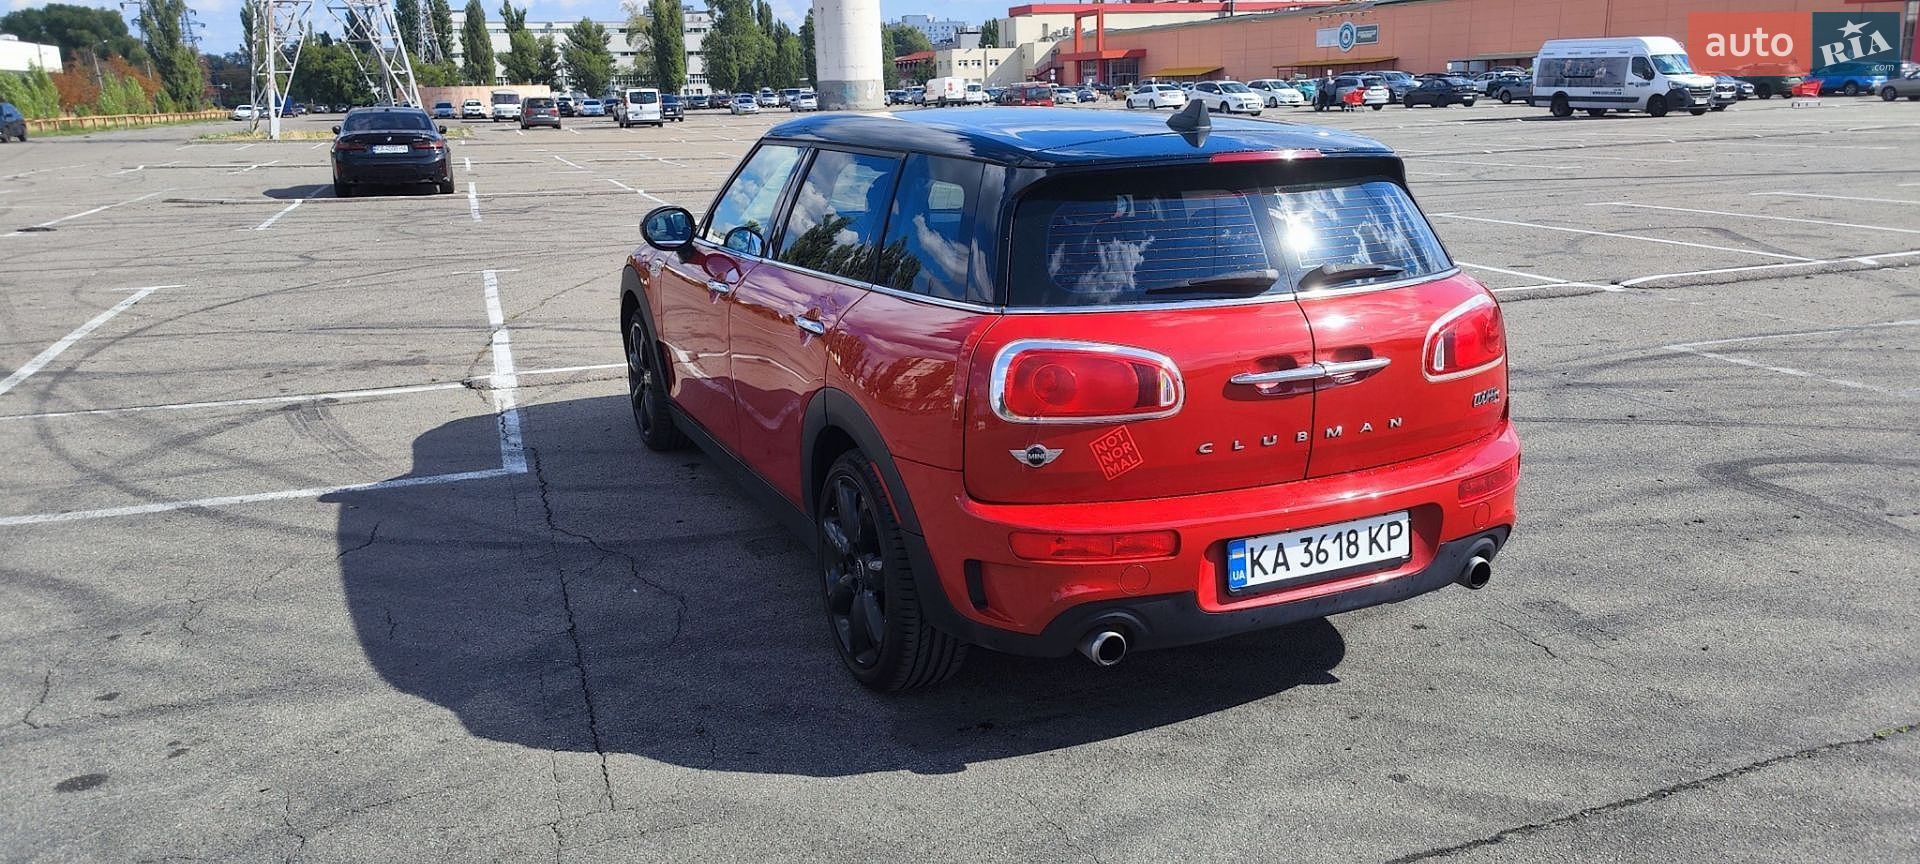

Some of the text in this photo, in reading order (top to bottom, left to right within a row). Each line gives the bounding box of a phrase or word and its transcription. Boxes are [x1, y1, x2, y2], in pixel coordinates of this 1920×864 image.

[1095, 430, 1125, 454] NOT
[1199, 417, 1403, 454] CLUBMAN
[1027, 452, 1046, 461] MINI
[1101, 441, 1132, 466] NOR
[1106, 455, 1138, 476] MAL
[1250, 520, 1403, 578] KA 3618 KP
[1232, 570, 1246, 581] UA
